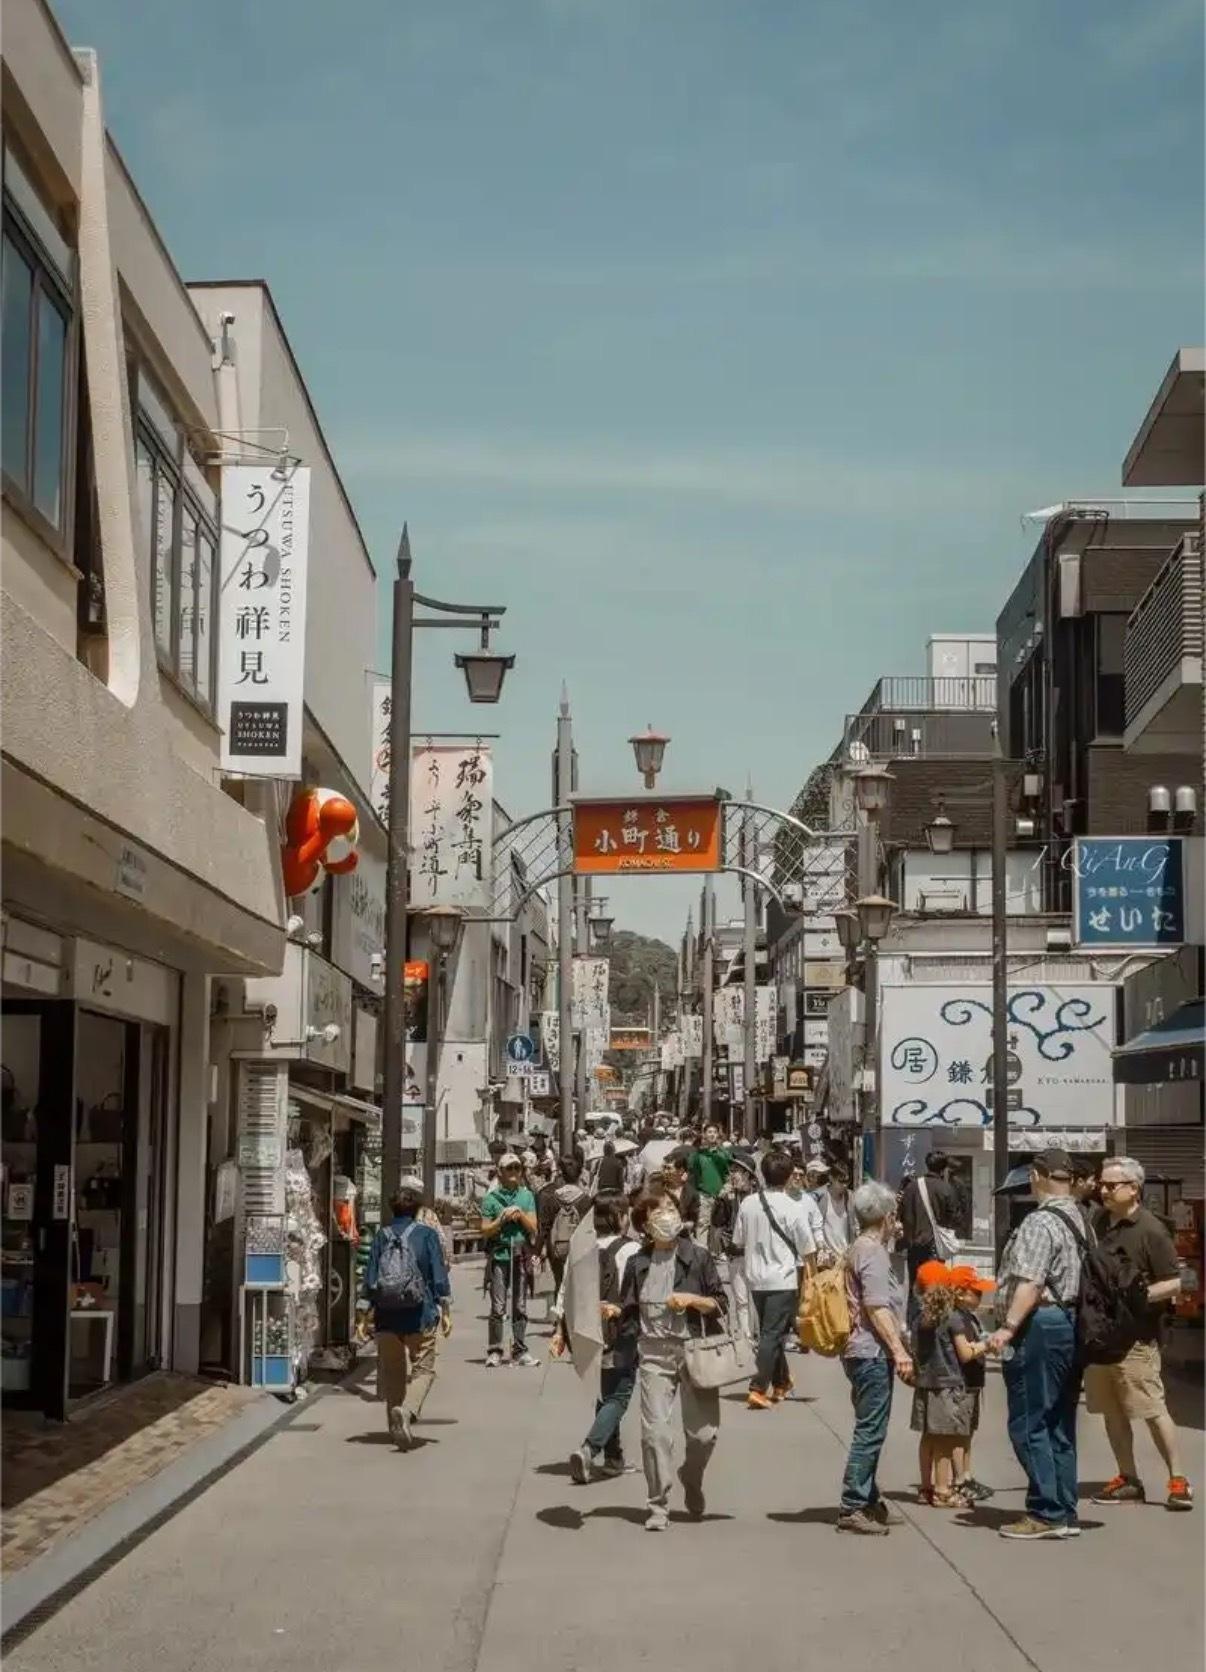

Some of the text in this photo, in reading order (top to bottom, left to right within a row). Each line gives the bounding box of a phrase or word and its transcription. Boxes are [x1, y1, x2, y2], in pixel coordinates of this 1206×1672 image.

[234, 483, 270, 685] うつわ祥見
[279, 567, 292, 642] SHOKEN
[594, 824, 700, 854] 小町通り
[904, 1047, 928, 1073] 居
